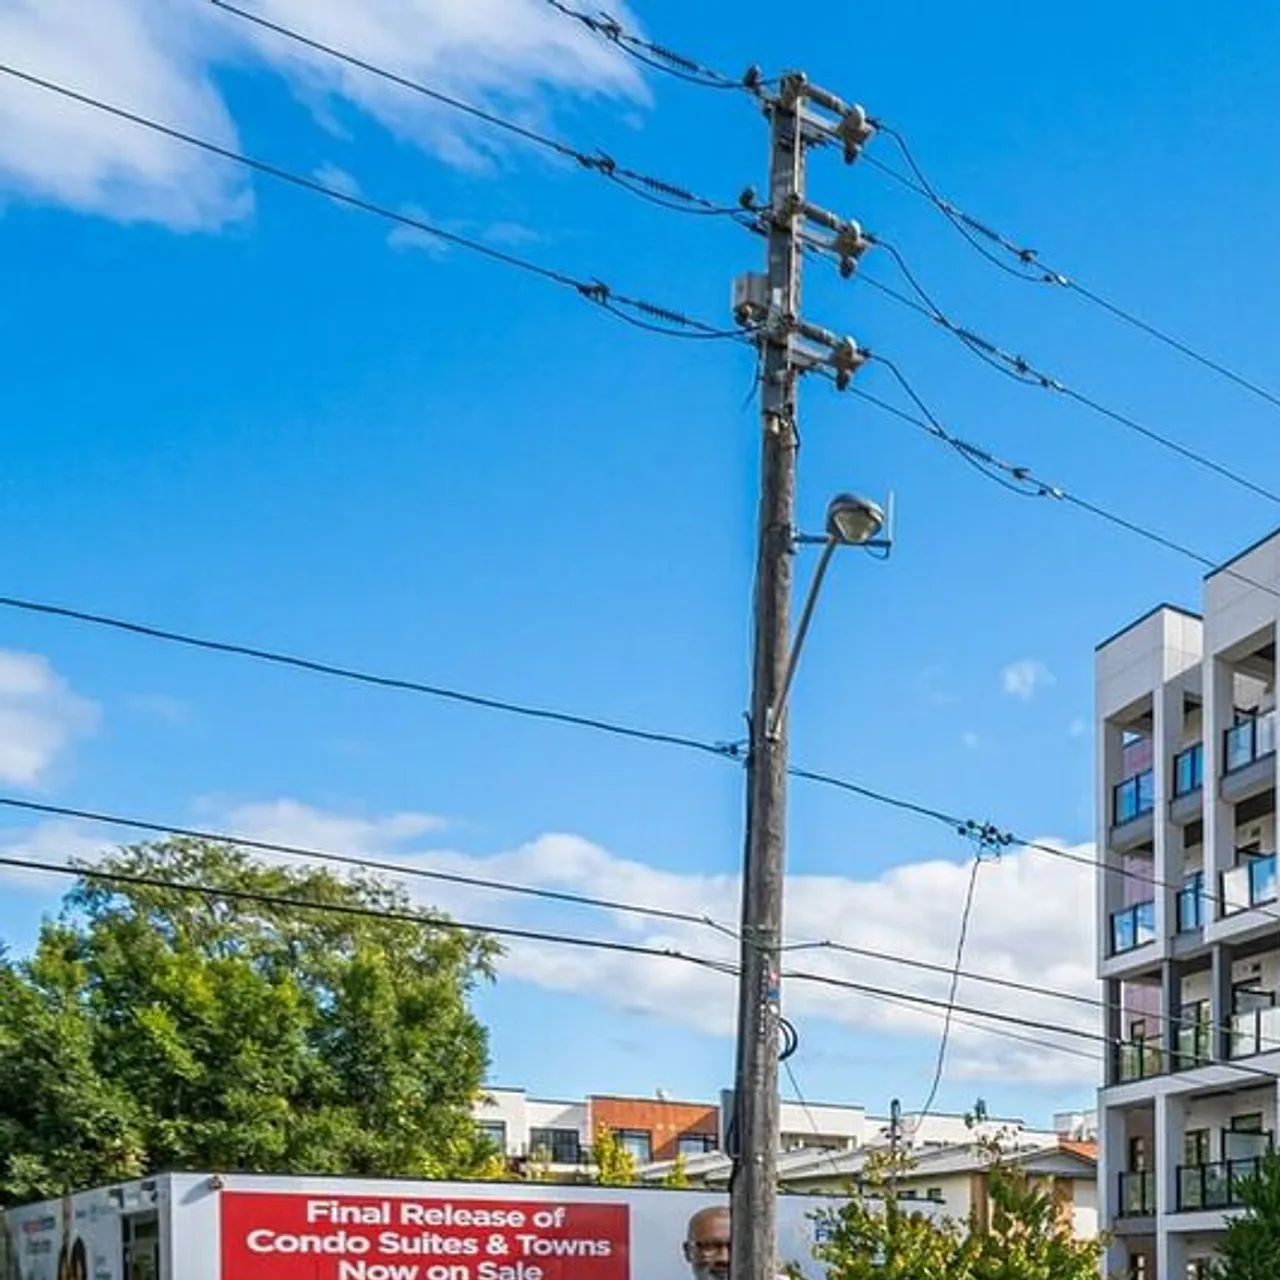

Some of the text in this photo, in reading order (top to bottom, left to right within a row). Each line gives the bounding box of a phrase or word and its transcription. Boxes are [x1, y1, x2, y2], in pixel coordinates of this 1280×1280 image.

[307, 1200, 565, 1229] Final Release of
[246, 1229, 611, 1257] Condo Suites & Towns
